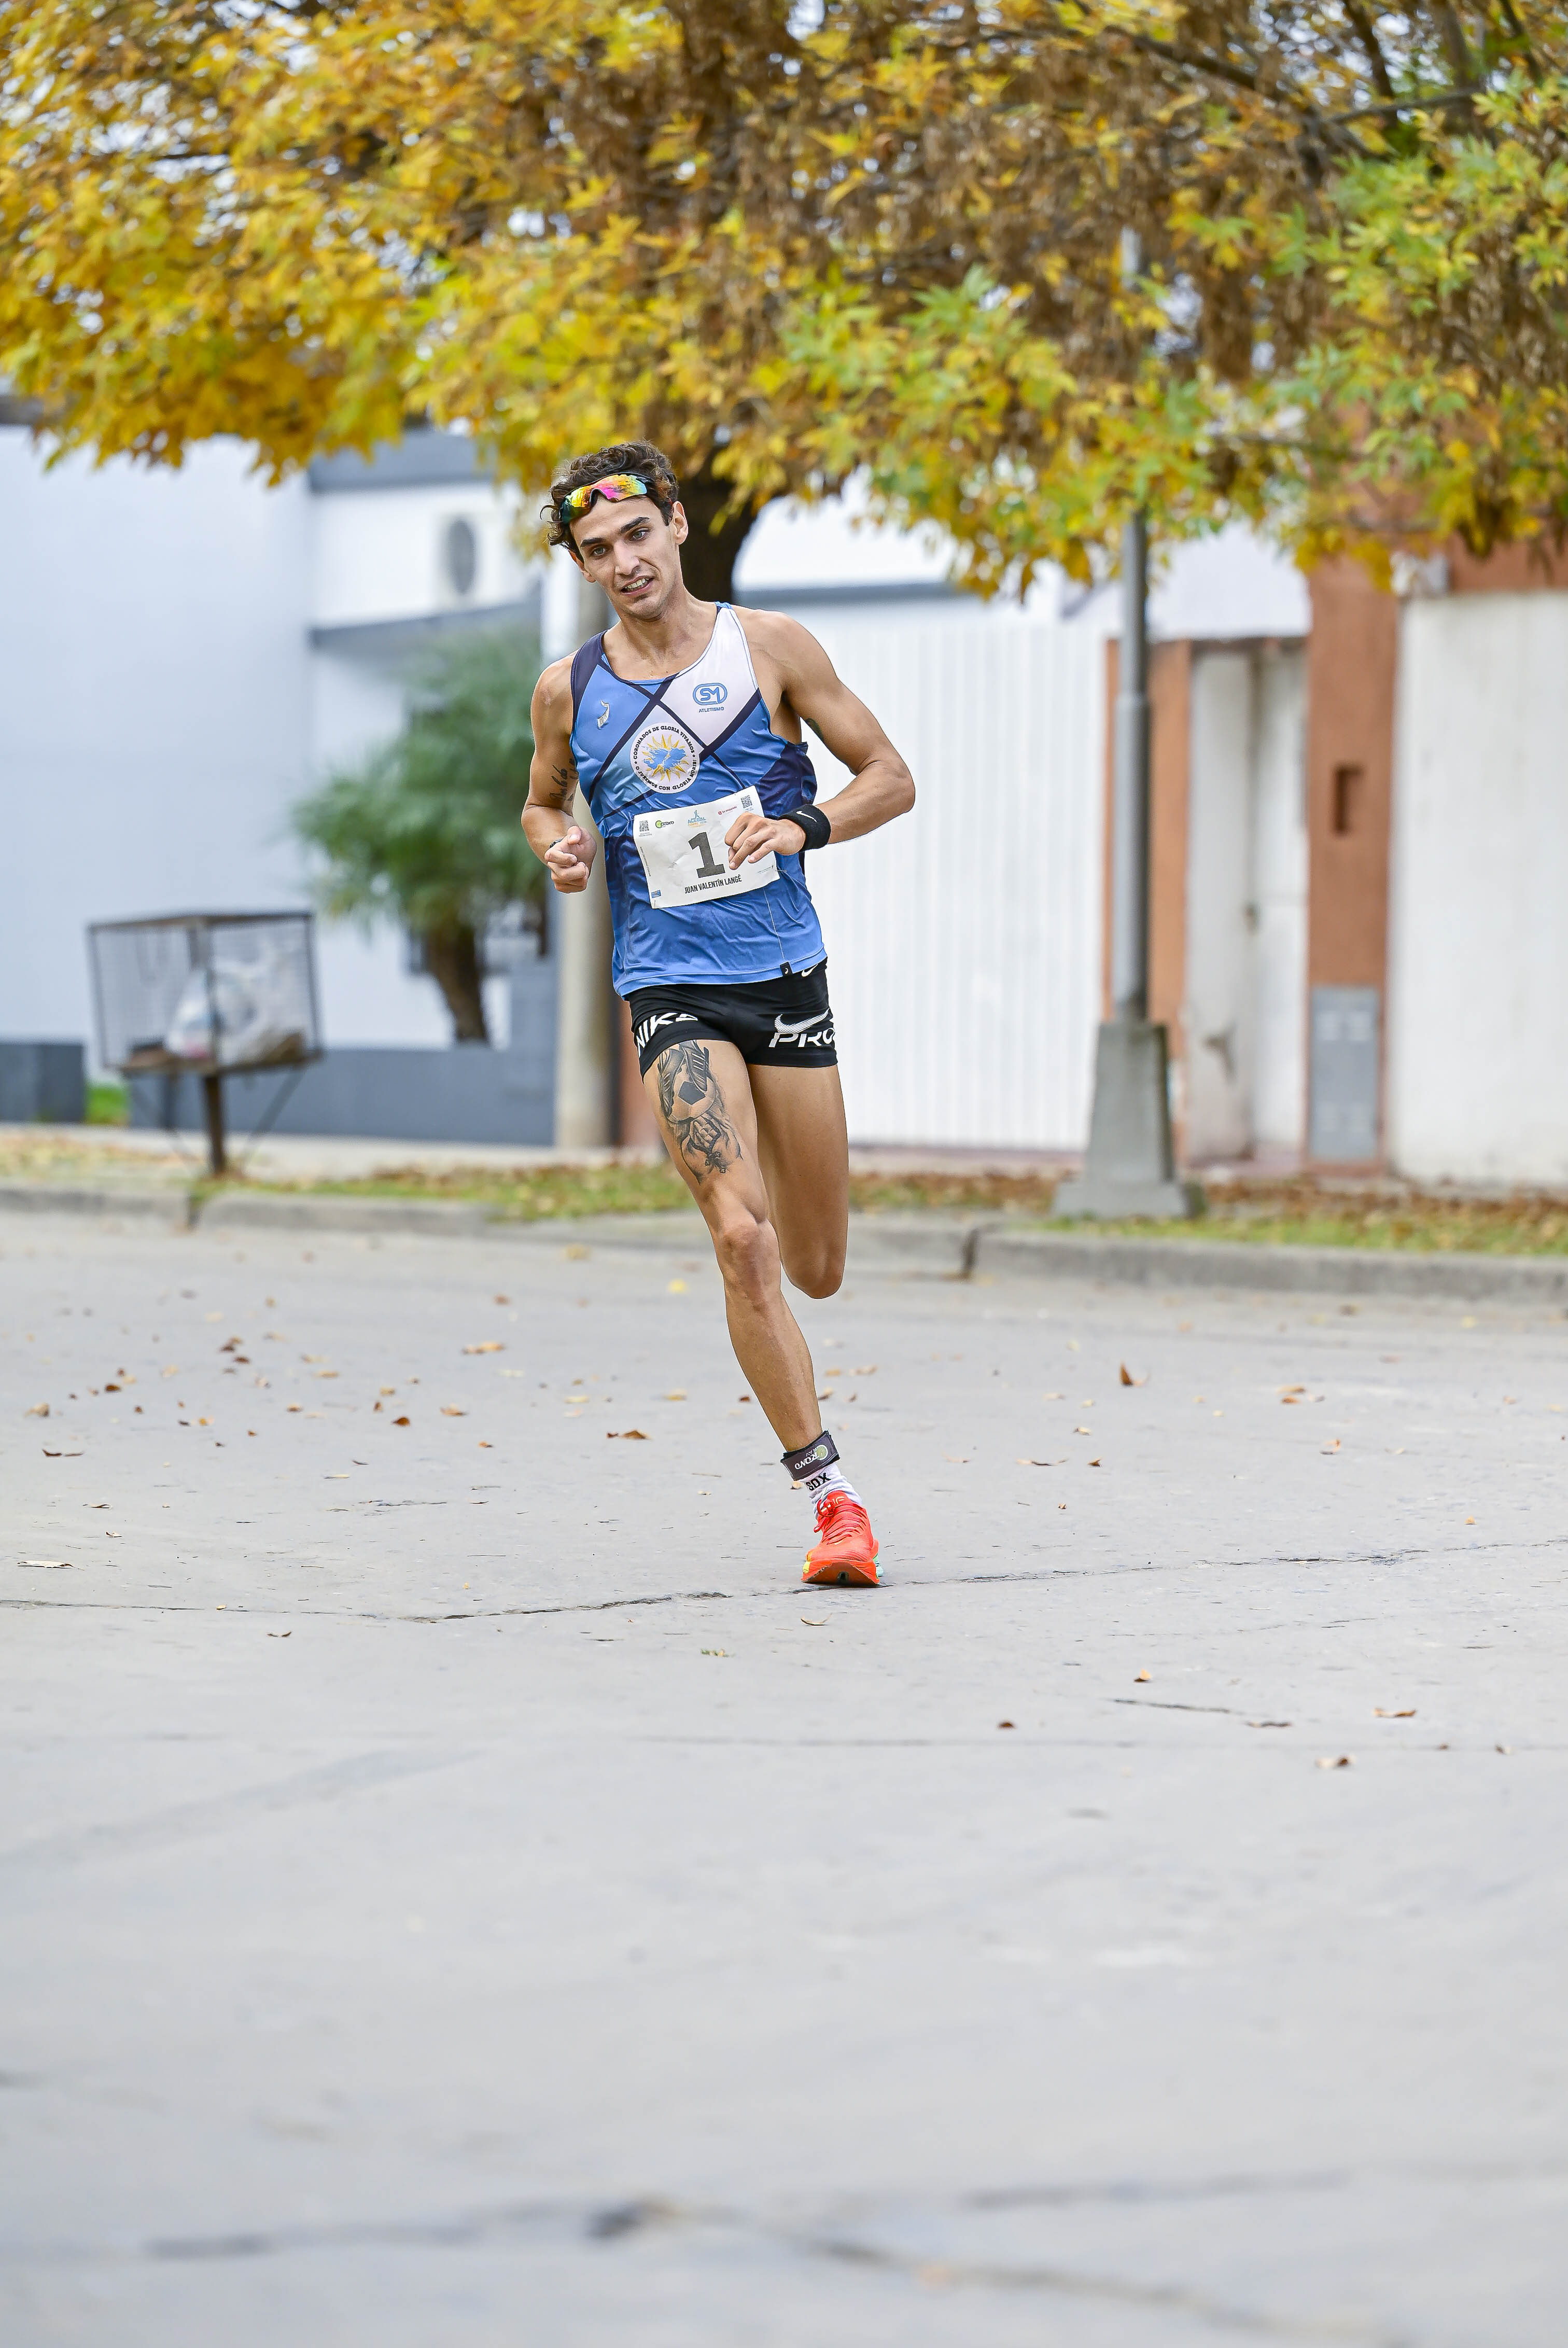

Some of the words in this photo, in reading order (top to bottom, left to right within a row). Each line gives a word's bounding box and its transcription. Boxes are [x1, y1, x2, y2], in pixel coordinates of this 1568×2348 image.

[700, 687, 720, 703] SM
[634, 730, 651, 759] CORONADOS
[680, 732, 695, 753] VIVAMOS
[638, 771, 657, 788] JUREMOS
[672, 778, 692, 790] GLORIA
[688, 832, 725, 878] 1
[684, 885, 698, 893] JUAN
[698, 879, 724, 890] VALENTÍN
[724, 874, 742, 885] LANGÉ
[769, 1027, 835, 1047] PRO
[806, 1473, 831, 1491] SOX
